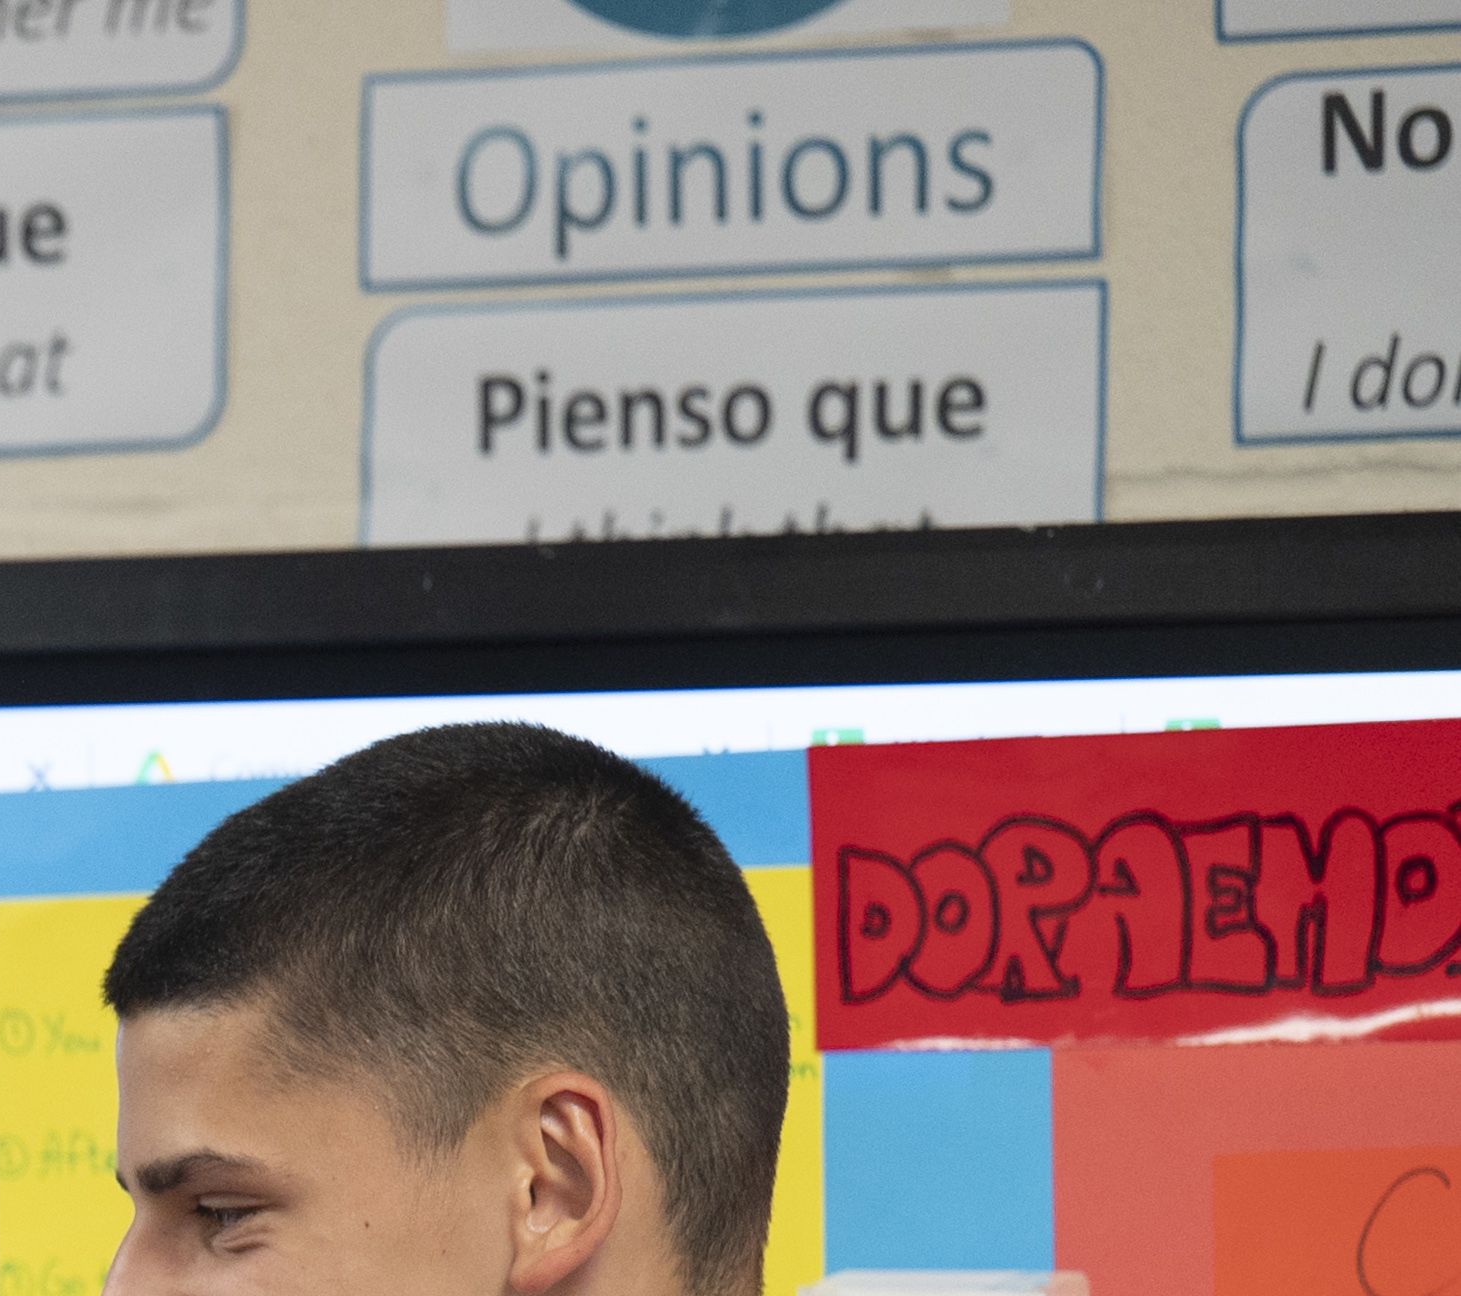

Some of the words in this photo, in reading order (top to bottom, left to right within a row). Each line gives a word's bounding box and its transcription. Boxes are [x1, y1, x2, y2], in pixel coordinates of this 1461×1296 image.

[1320, 90, 1457, 177] No
[454, 110, 998, 262] Opinions
[476, 370, 776, 458] Pienso
[806, 375, 990, 464] que
[1304, 340, 1328, 415] I
[836, 806, 1461, 1006] DORAEMO
